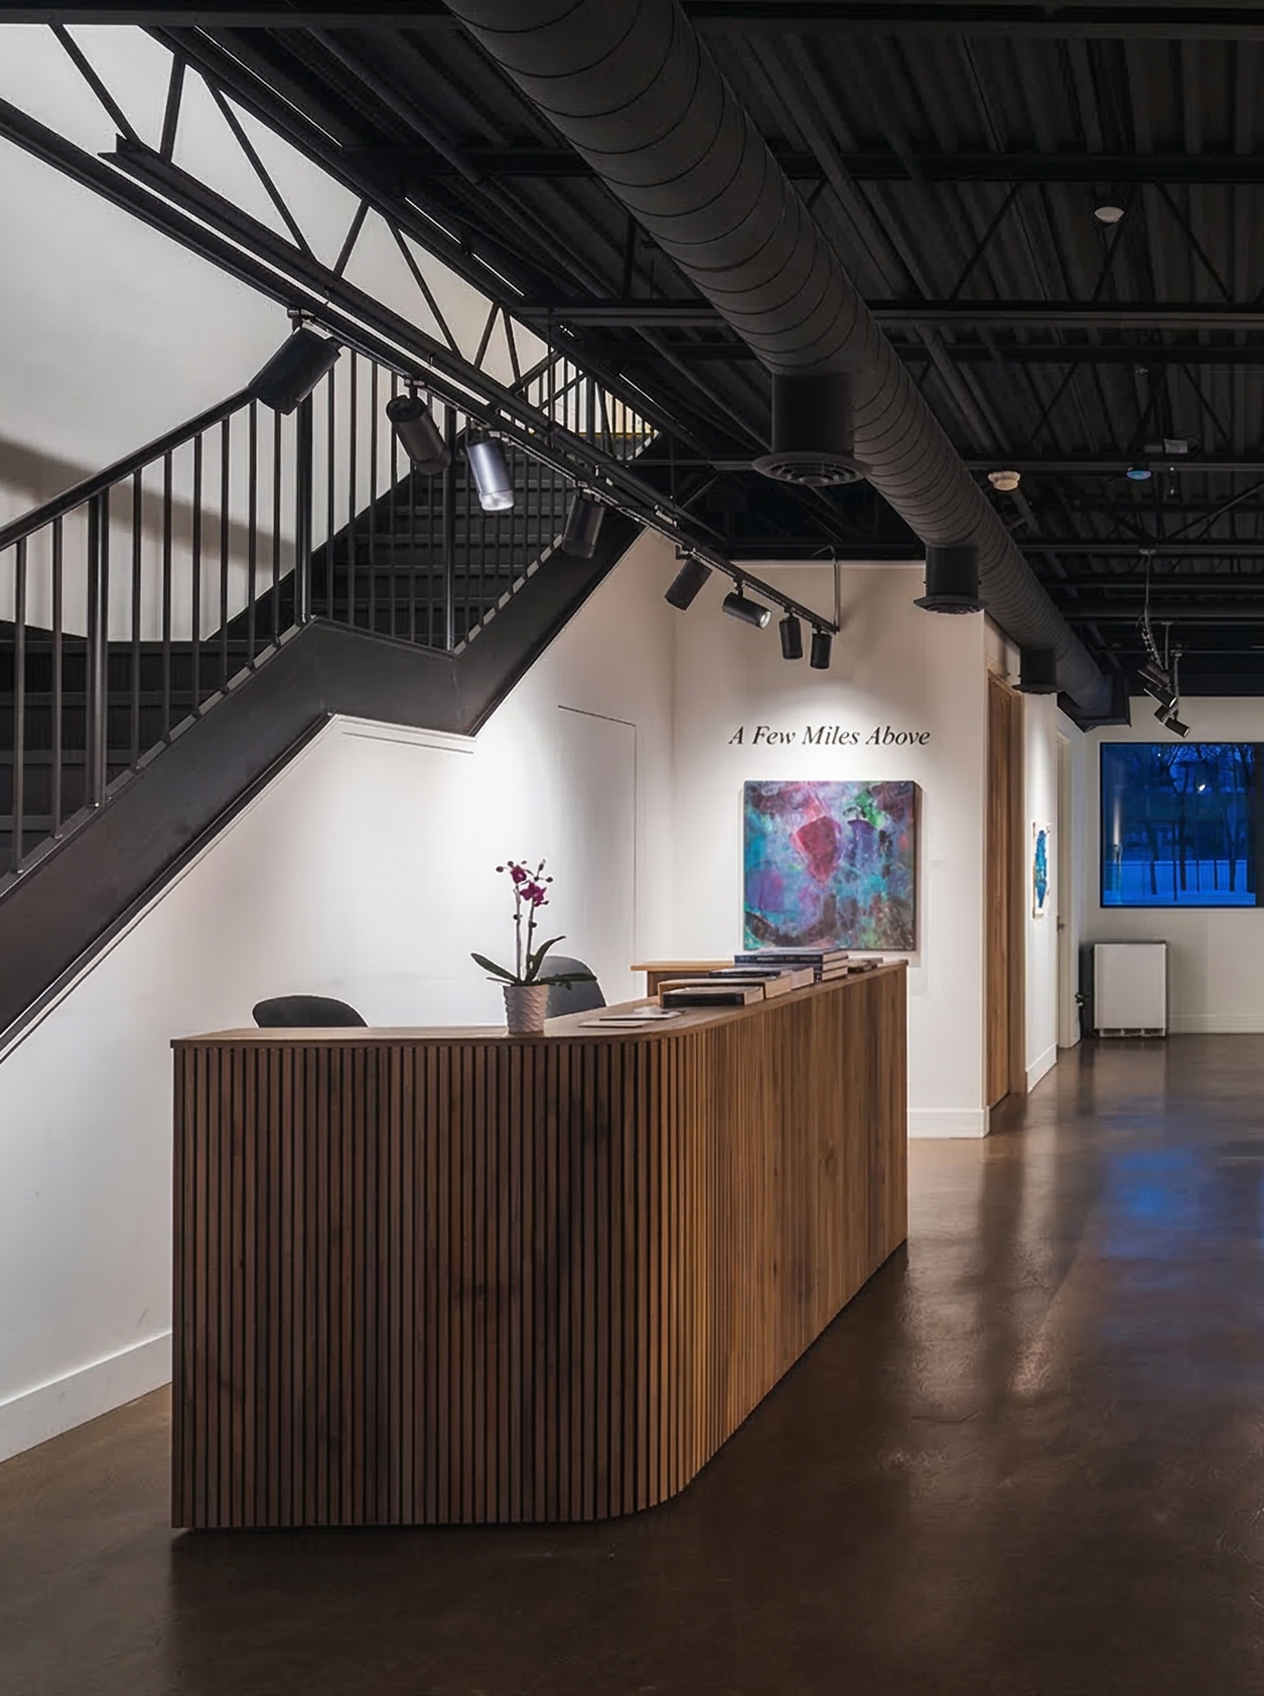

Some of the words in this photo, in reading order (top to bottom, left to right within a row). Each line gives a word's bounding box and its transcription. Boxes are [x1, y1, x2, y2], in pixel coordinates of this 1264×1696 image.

[728, 726, 744, 745] A
[751, 726, 796, 745] Few
[801, 726, 860, 745] Miles
[865, 726, 931, 745] Above
